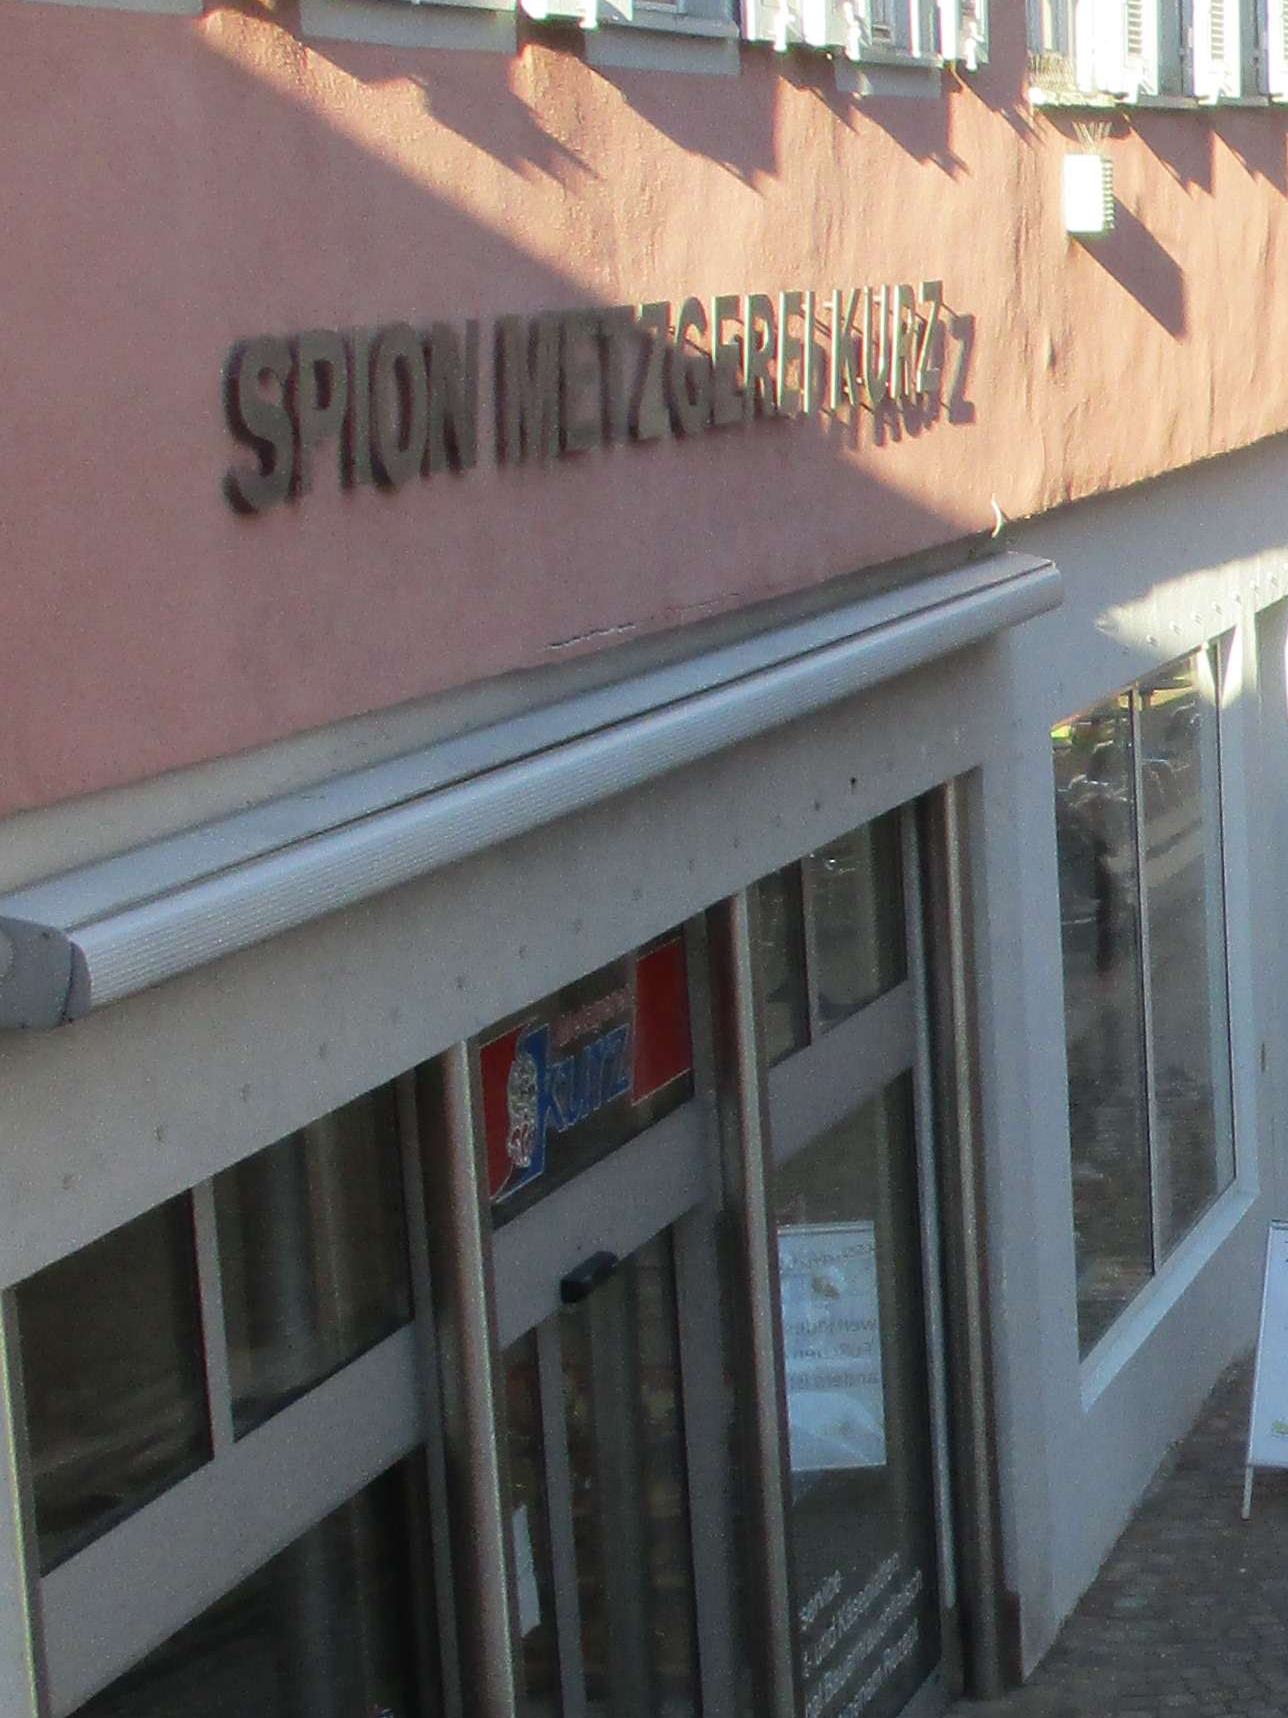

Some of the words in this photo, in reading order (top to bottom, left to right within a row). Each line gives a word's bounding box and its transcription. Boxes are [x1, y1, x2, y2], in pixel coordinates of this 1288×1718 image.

[223, 318, 479, 516] SPION
[494, 291, 816, 470] METZGEREI
[829, 281, 945, 411] KURZ
